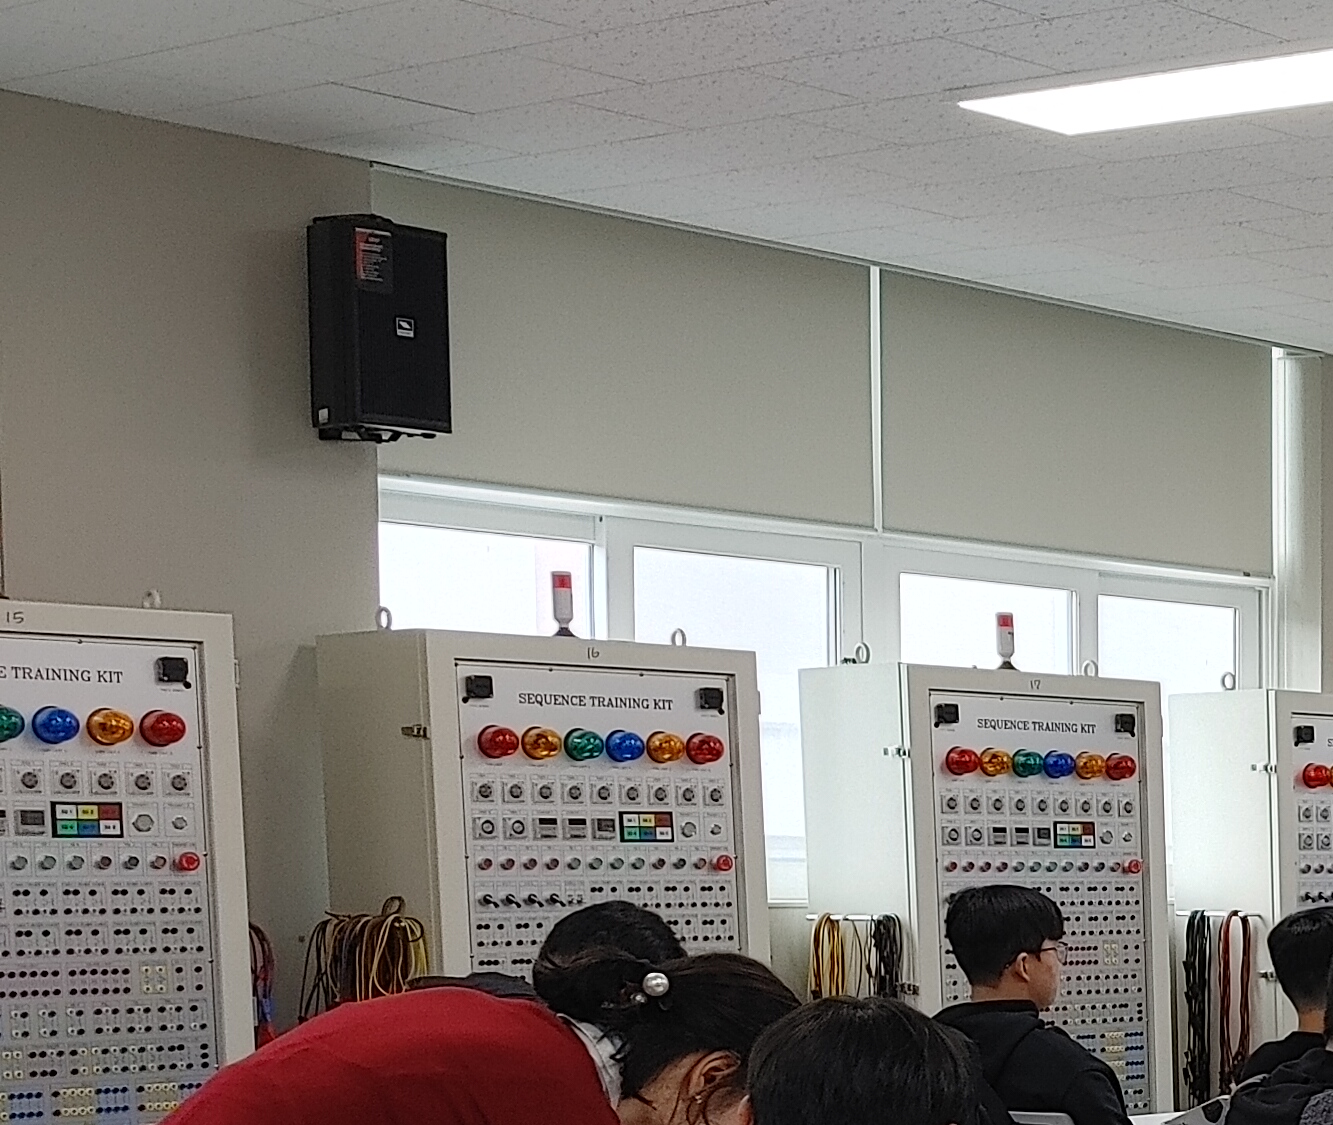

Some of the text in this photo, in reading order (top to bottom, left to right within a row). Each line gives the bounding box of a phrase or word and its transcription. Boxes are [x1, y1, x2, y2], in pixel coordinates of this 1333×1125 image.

[6, 611, 24, 624] 15
[587, 648, 599, 659] 16
[11, 666, 91, 682] TRAINING
[97, 670, 123, 684] KIT
[1030, 679, 1041, 690] 17
[518, 692, 674, 711] SEQUENCE TRAINING KIT
[977, 718, 1097, 735] SEQUENCE TRAINING KIT
